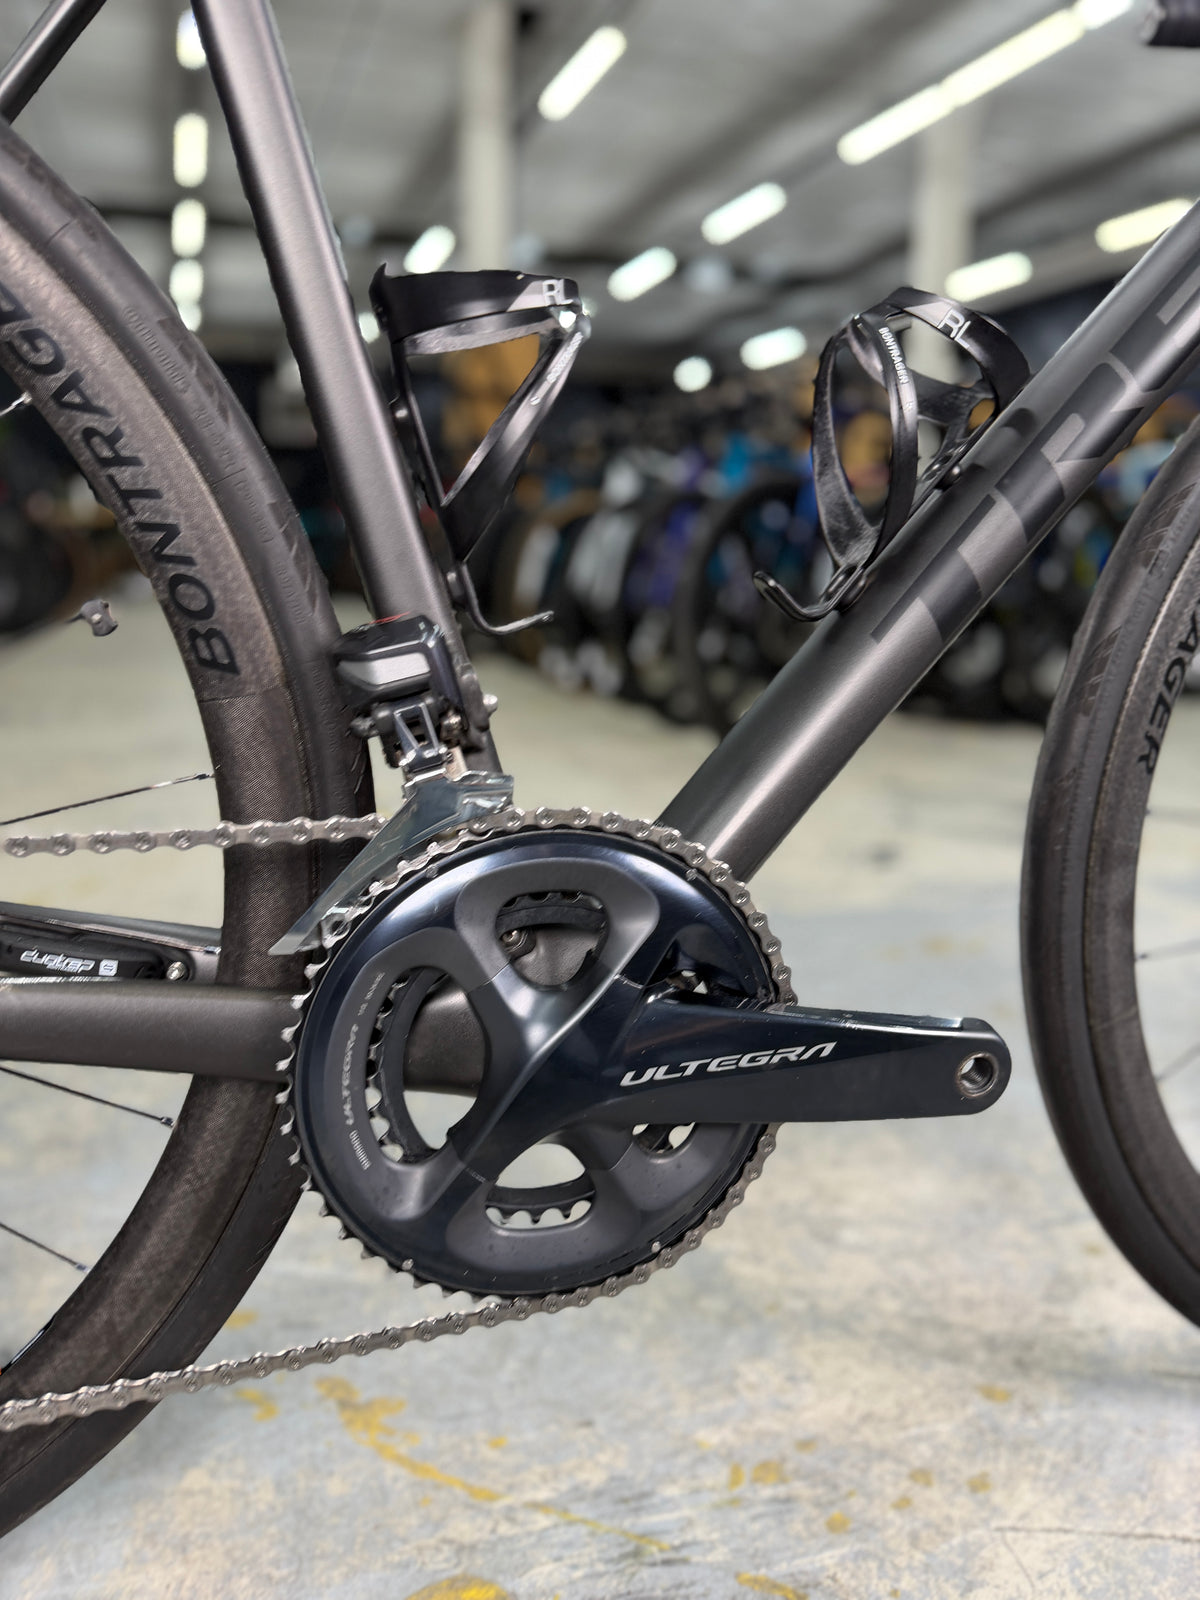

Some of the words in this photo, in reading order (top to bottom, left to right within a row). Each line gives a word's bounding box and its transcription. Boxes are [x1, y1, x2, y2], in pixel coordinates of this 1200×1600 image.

[543, 279, 574, 306] RL
[936, 309, 972, 349] RL
[1138, 598, 1200, 775] AGER
[620, 1041, 837, 1087] ULTEGRA
